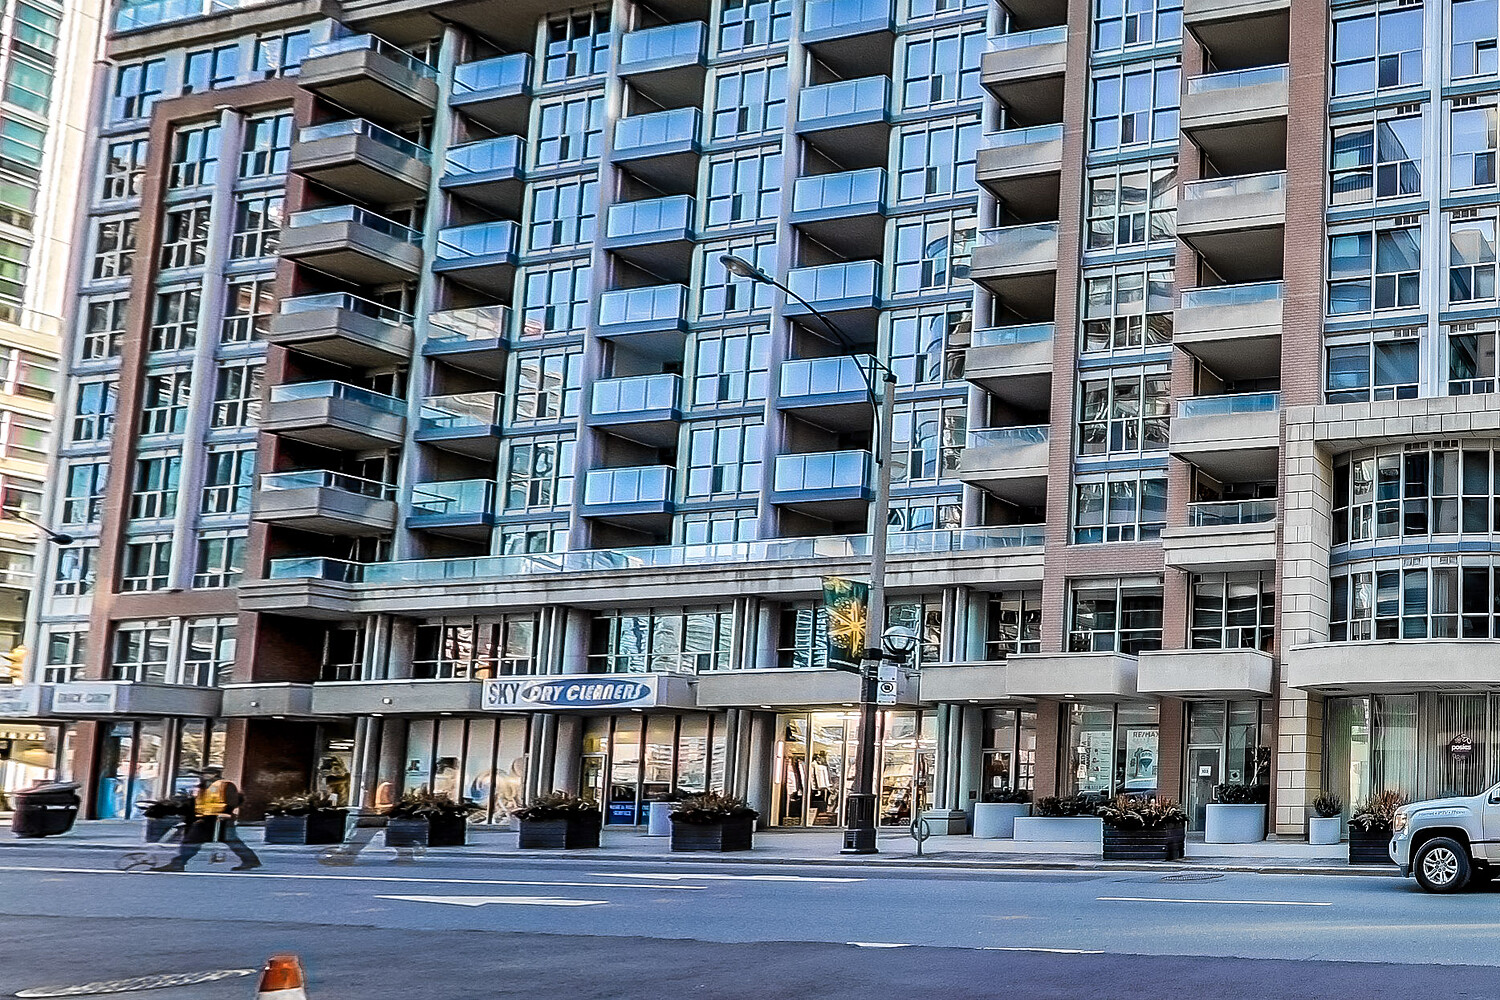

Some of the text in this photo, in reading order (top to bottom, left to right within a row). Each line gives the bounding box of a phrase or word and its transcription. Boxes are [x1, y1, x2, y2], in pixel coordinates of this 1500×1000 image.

[488, 683, 642, 704] SKY DRY CLEANERS
[1452, 743, 1471, 751] posies
